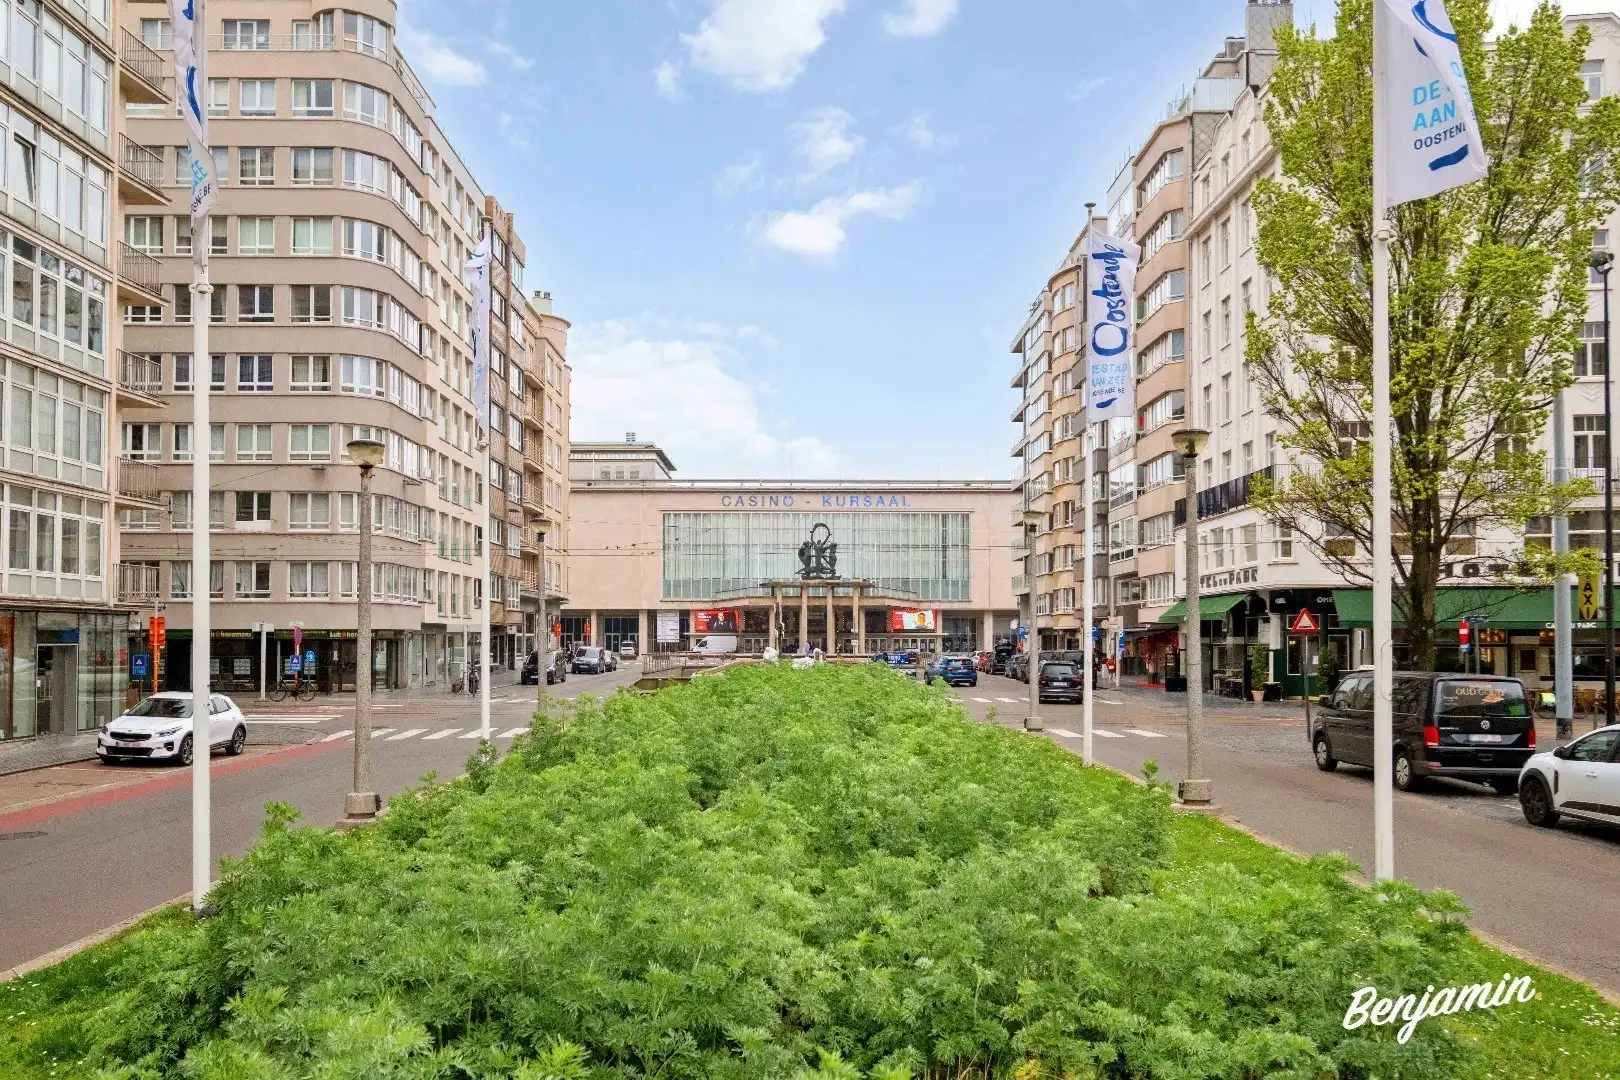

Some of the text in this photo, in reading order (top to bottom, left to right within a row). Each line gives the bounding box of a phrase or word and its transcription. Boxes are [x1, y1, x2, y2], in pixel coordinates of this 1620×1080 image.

[1413, 79, 1441, 106] DE
[1412, 100, 1456, 132] AAN
[1414, 121, 1466, 150] OOSTEN
[1092, 244, 1127, 356] Oostende
[721, 495, 794, 507] CASINO
[822, 495, 911, 507] KURSAAL
[1199, 575, 1218, 589] TEL
[1582, 580, 1593, 618] AXI
[1455, 687, 1476, 696] OUD
